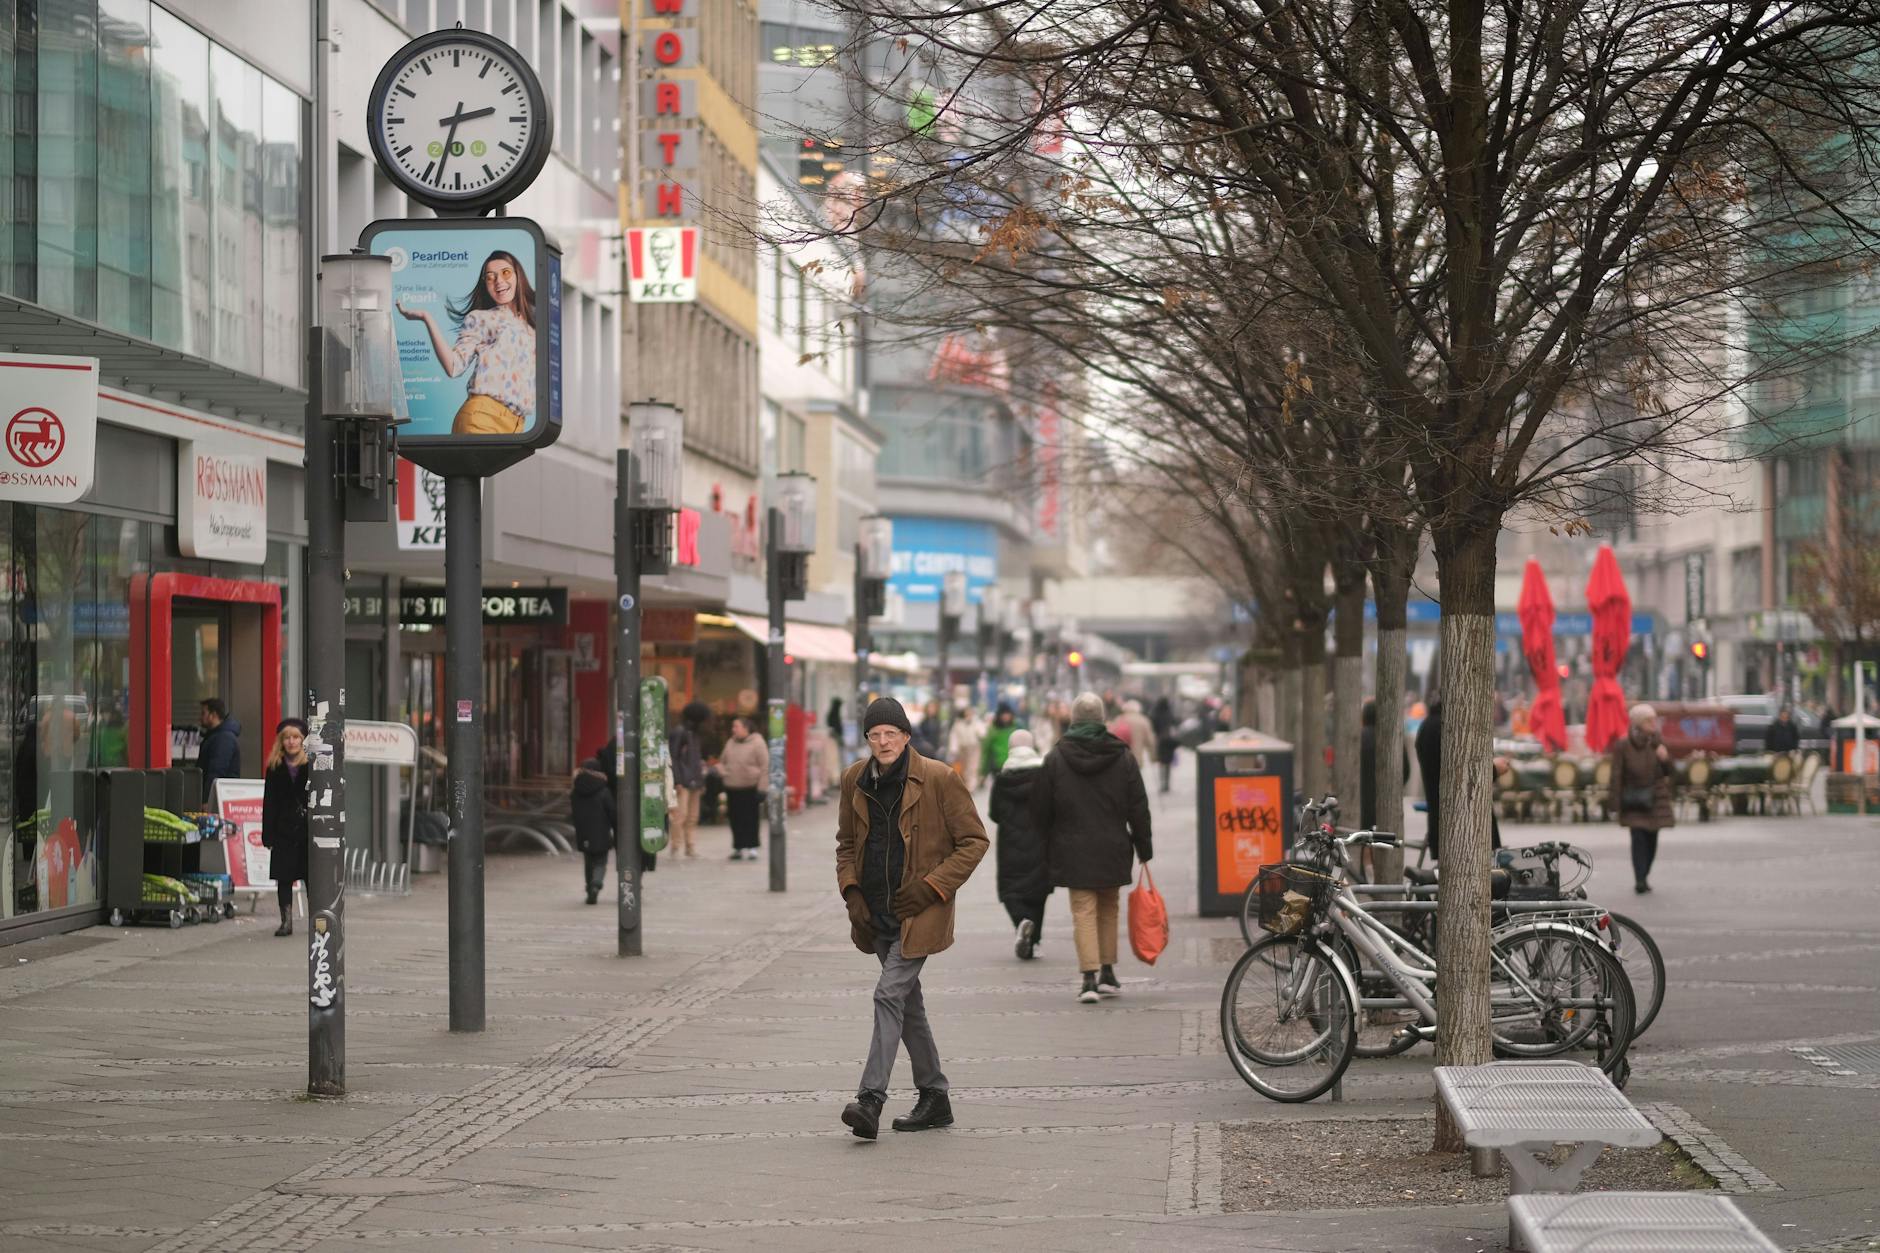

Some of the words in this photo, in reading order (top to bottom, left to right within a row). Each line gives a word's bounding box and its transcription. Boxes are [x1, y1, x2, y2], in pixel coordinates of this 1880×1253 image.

[412, 250, 469, 261] PearlDent
[642, 282, 686, 297] KFC
[0, 471, 77, 487] OSSMANN
[197, 455, 264, 507] ROSSMANN
[411, 526, 447, 545] KF
[481, 597, 516, 617] FOR
[518, 597, 554, 616] TEA
